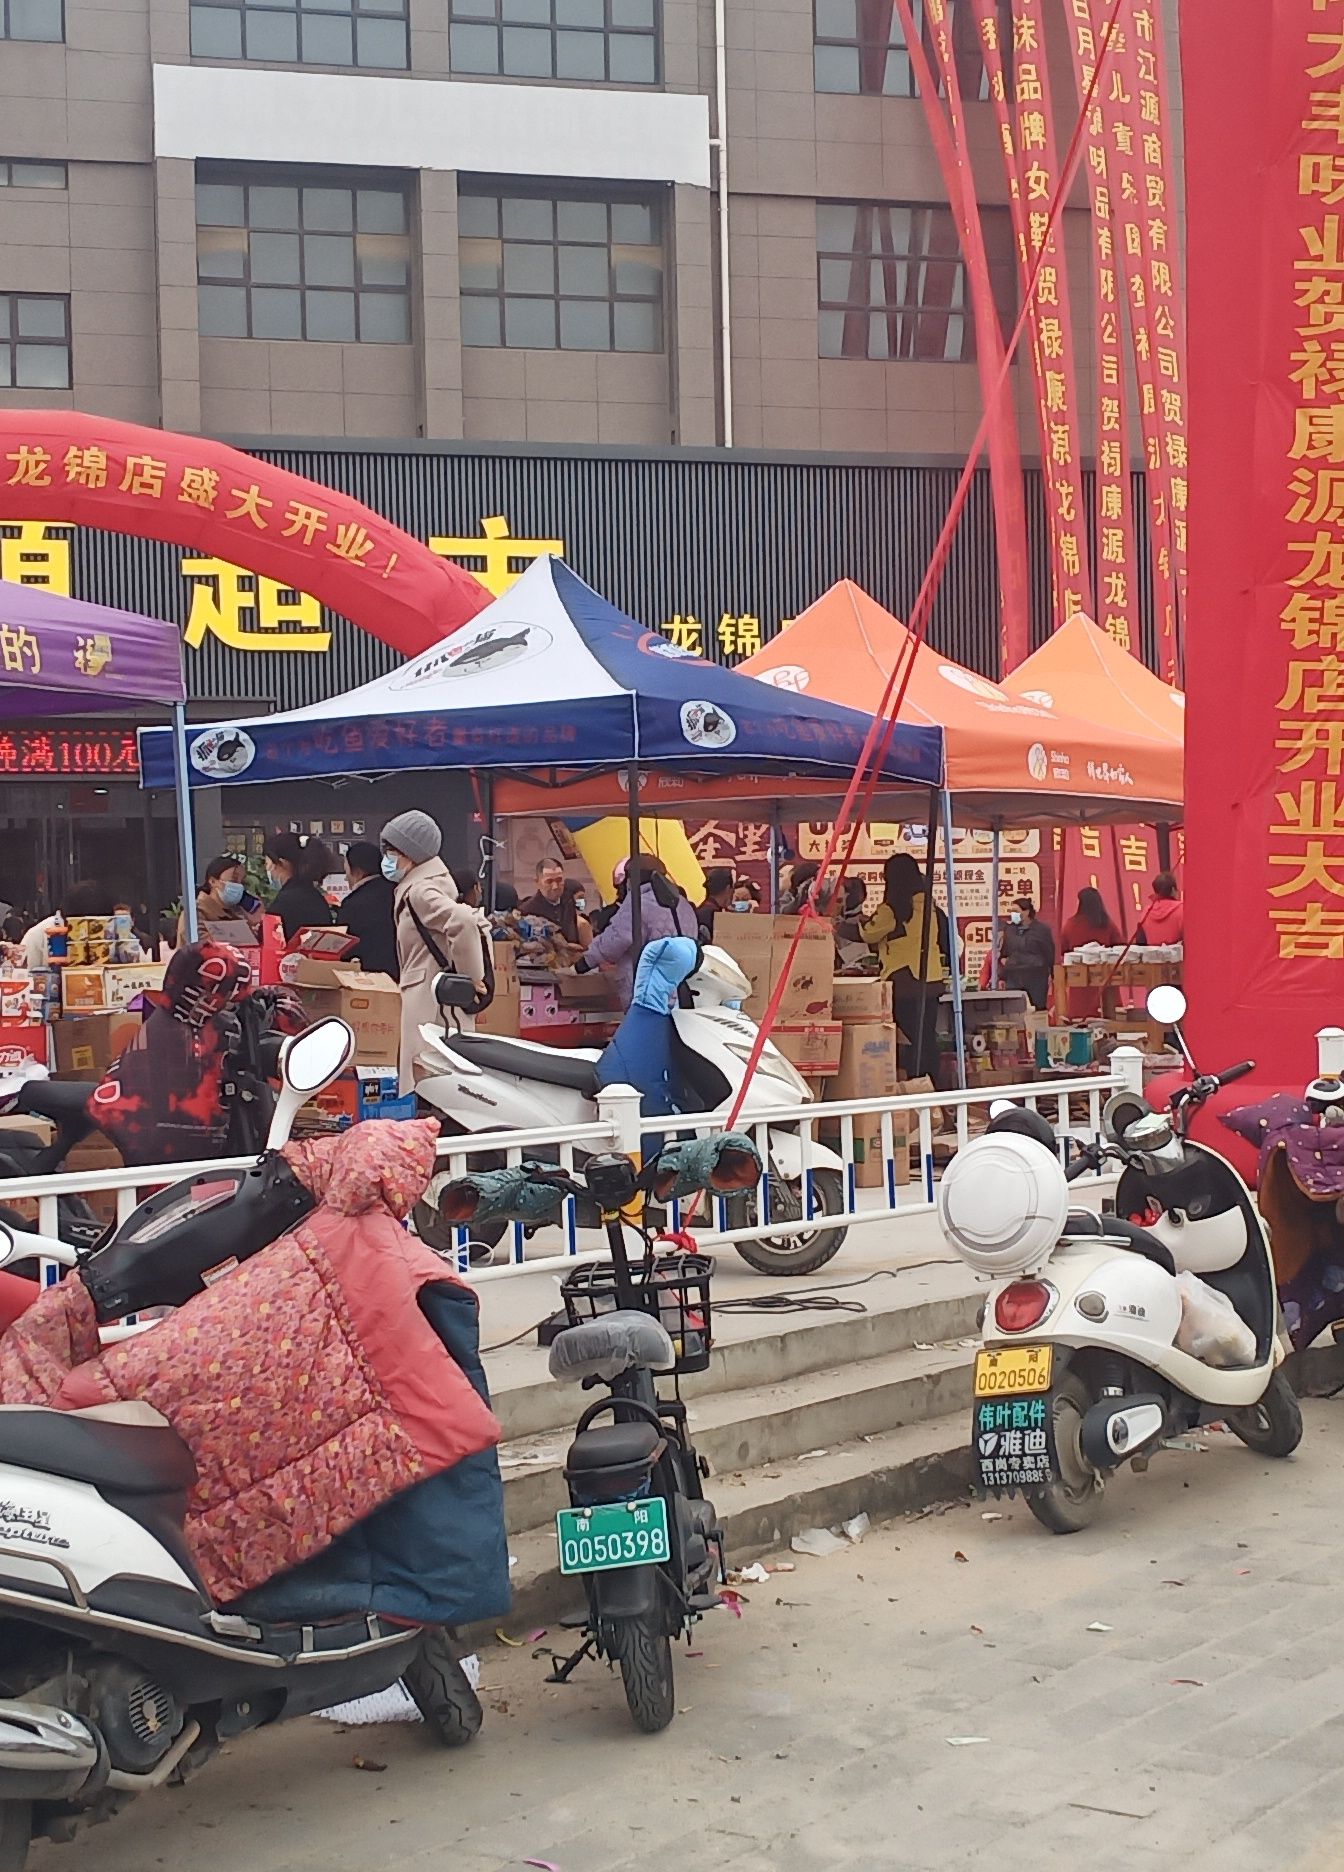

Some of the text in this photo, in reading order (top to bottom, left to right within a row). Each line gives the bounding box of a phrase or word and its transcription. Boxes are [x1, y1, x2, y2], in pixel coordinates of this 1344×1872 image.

[661, 613, 802, 657] 龙锦
[978, 1367, 1047, 1392] 0020506
[999, 1428, 1047, 1456] 雅迪
[565, 1528, 664, 1567] 0050398
